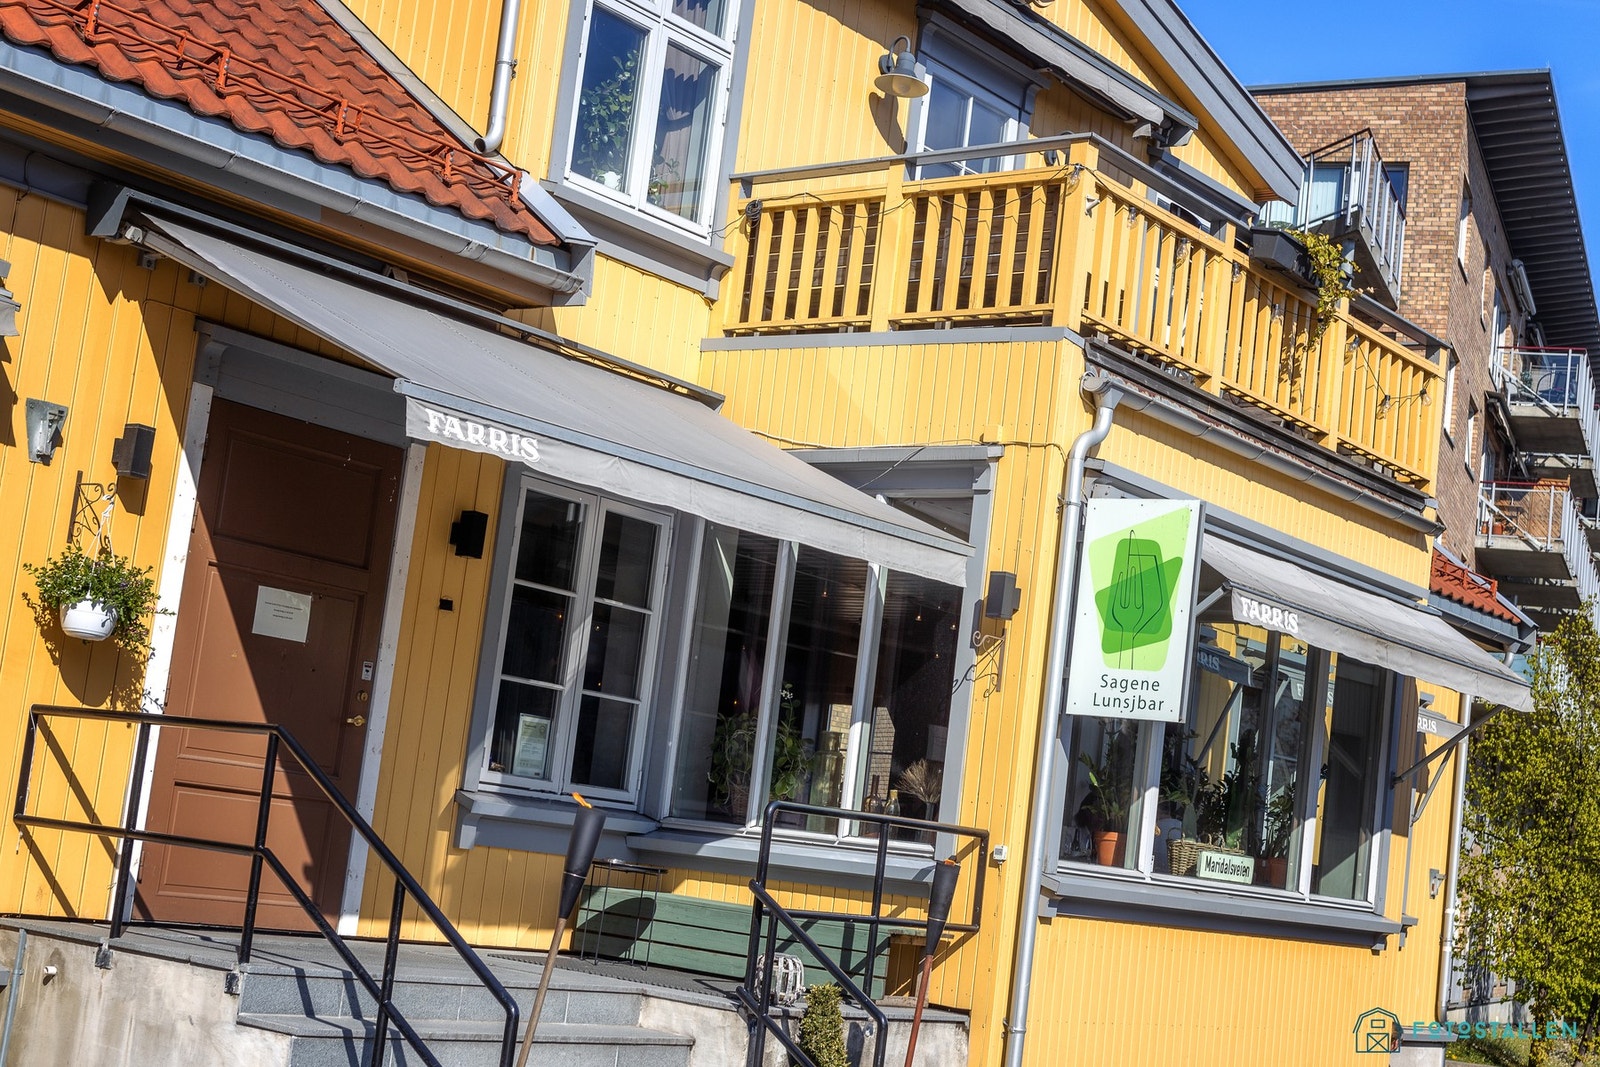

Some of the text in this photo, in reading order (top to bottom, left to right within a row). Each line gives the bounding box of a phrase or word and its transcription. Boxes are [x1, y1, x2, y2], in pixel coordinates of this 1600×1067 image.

[424, 407, 542, 463] FARRIS
[1240, 596, 1299, 633] FARRIS
[1100, 674, 1160, 693] Sagene
[1093, 692, 1164, 713] Lunsjbar
[1204, 855, 1250, 878] Maridalsveien
